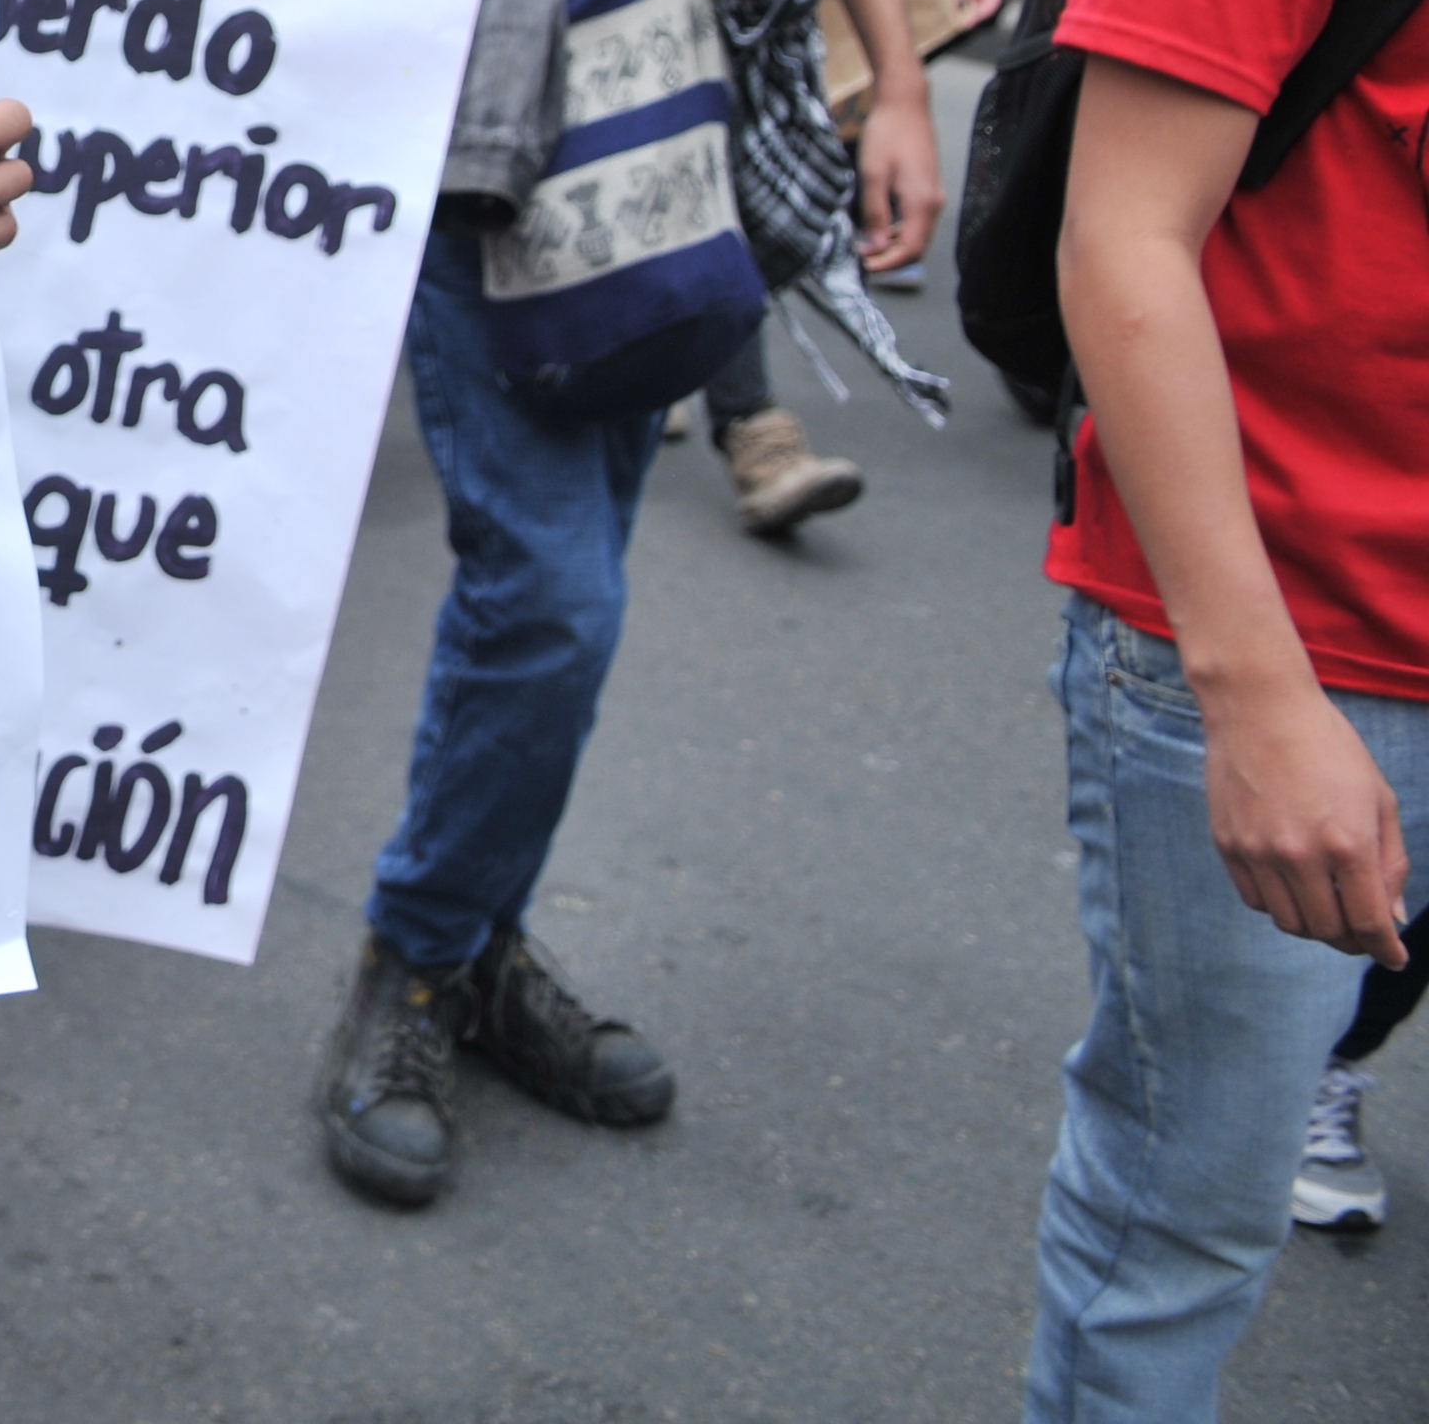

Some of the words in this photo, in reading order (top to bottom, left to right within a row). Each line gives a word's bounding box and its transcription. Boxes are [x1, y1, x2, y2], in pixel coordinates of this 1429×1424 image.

[30, 309, 248, 454] otra
[22, 474, 218, 606] que
[32, 719, 248, 905] ción
